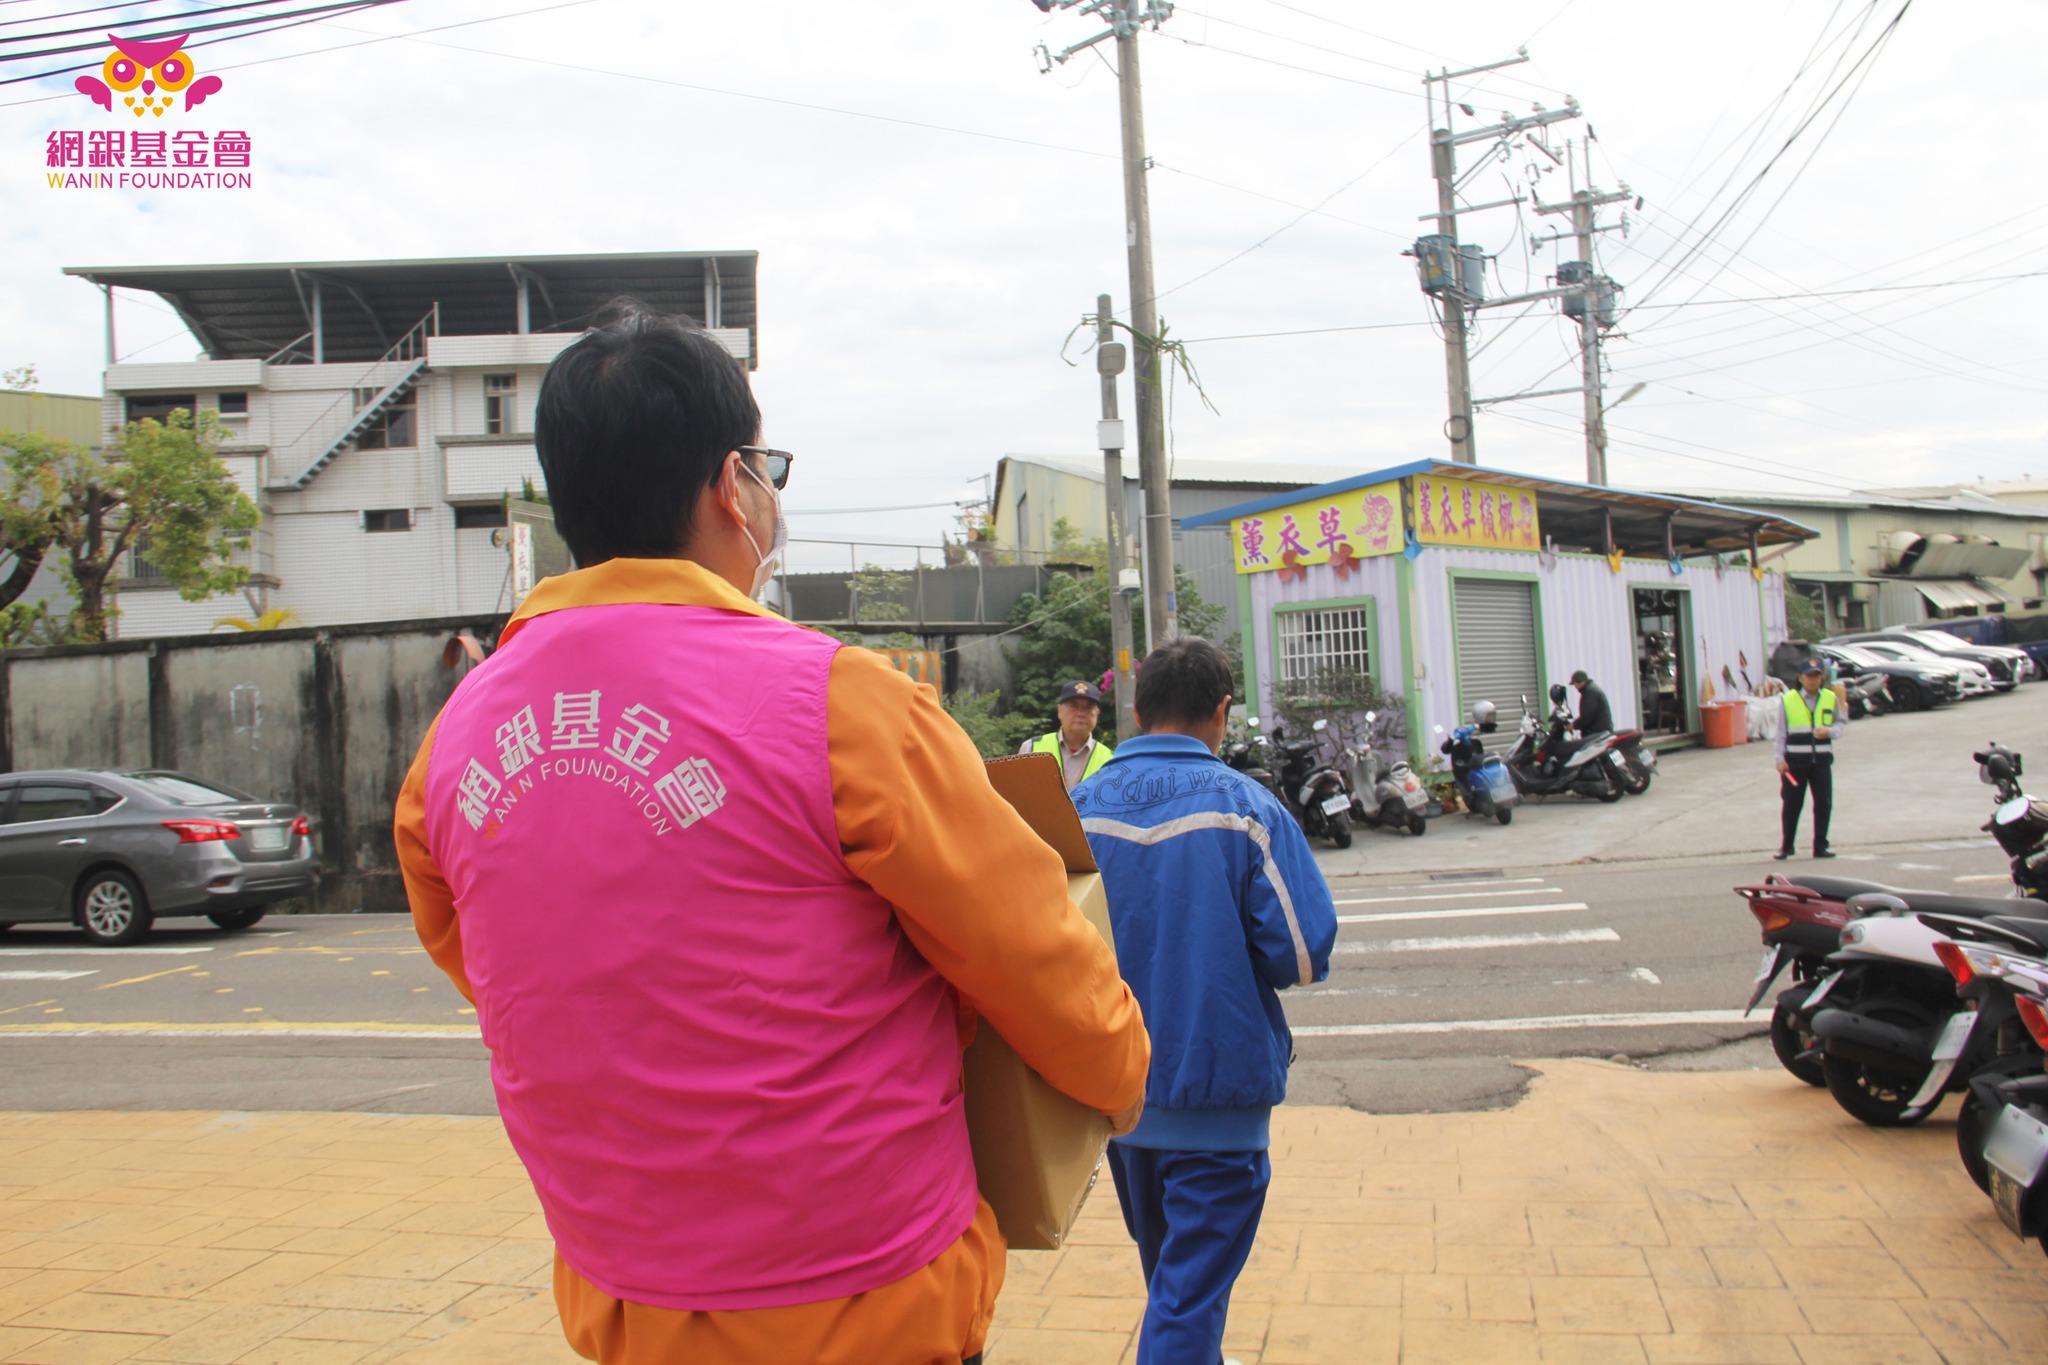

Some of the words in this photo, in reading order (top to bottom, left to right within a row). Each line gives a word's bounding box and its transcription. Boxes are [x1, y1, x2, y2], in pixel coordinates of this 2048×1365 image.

[456, 689, 728, 832] 網銀基金會
[483, 773, 534, 840] WANIN
[540, 757, 673, 837] FOUNDATION
